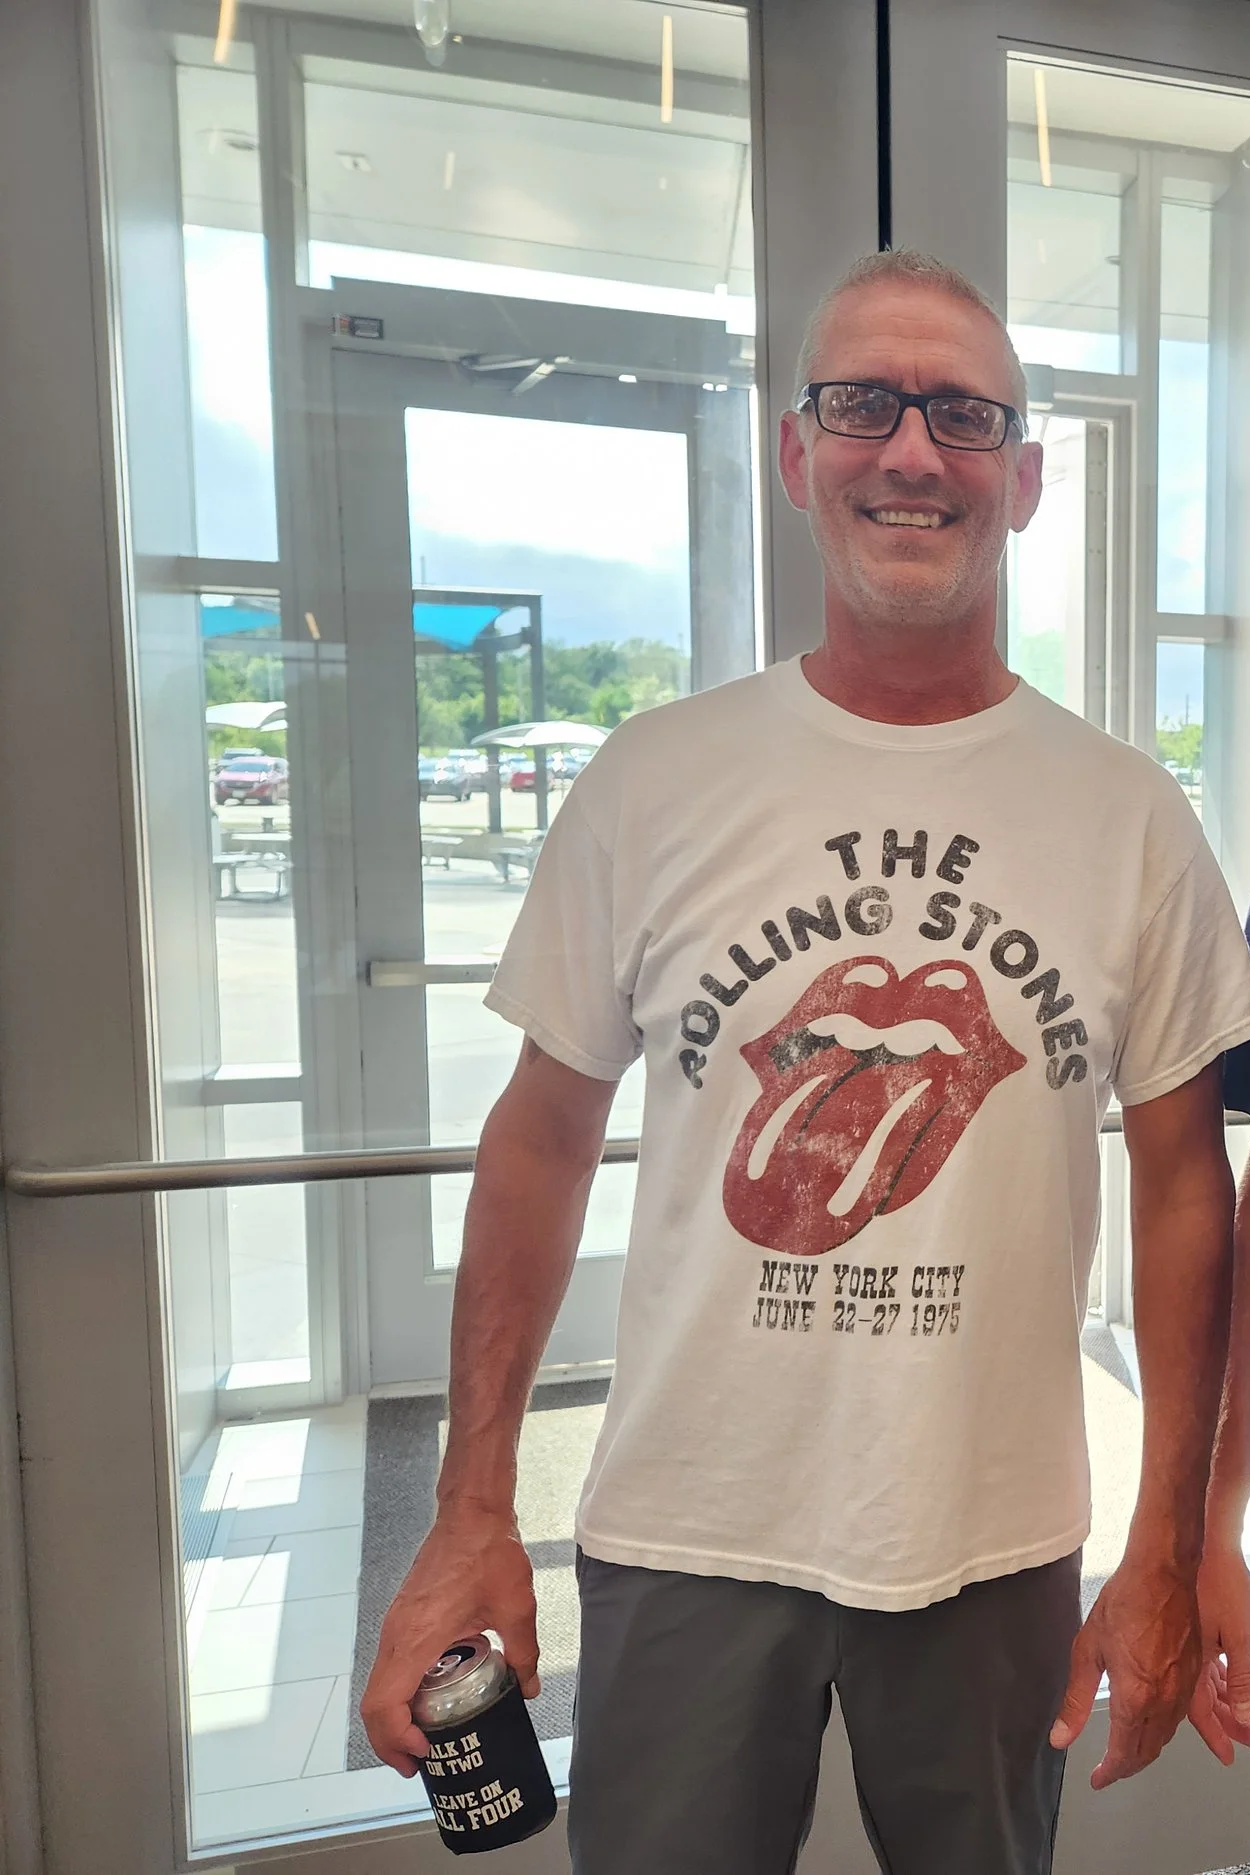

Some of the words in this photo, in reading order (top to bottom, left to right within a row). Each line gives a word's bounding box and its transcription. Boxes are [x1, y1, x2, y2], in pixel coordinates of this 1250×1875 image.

[825, 829, 980, 884] THE
[679, 886, 893, 1090] ROLLING
[919, 892, 1089, 1091] STONES
[759, 1260, 819, 1296] NEW
[833, 1263, 899, 1299] YORK
[911, 1264, 965, 1299] CITY
[752, 1297, 817, 1333] JUNE
[832, 1300, 901, 1336] 22-27
[910, 1301, 961, 1337] 1975
[425, 1761, 445, 1776] ON
[446, 1751, 484, 1775] TWO
[427, 1741, 459, 1759] ALK
[460, 1732, 481, 1753] IN
[432, 1792, 479, 1810] LEAVE
[480, 1779, 503, 1802] ON
[467, 1787, 524, 1830] FOUR
